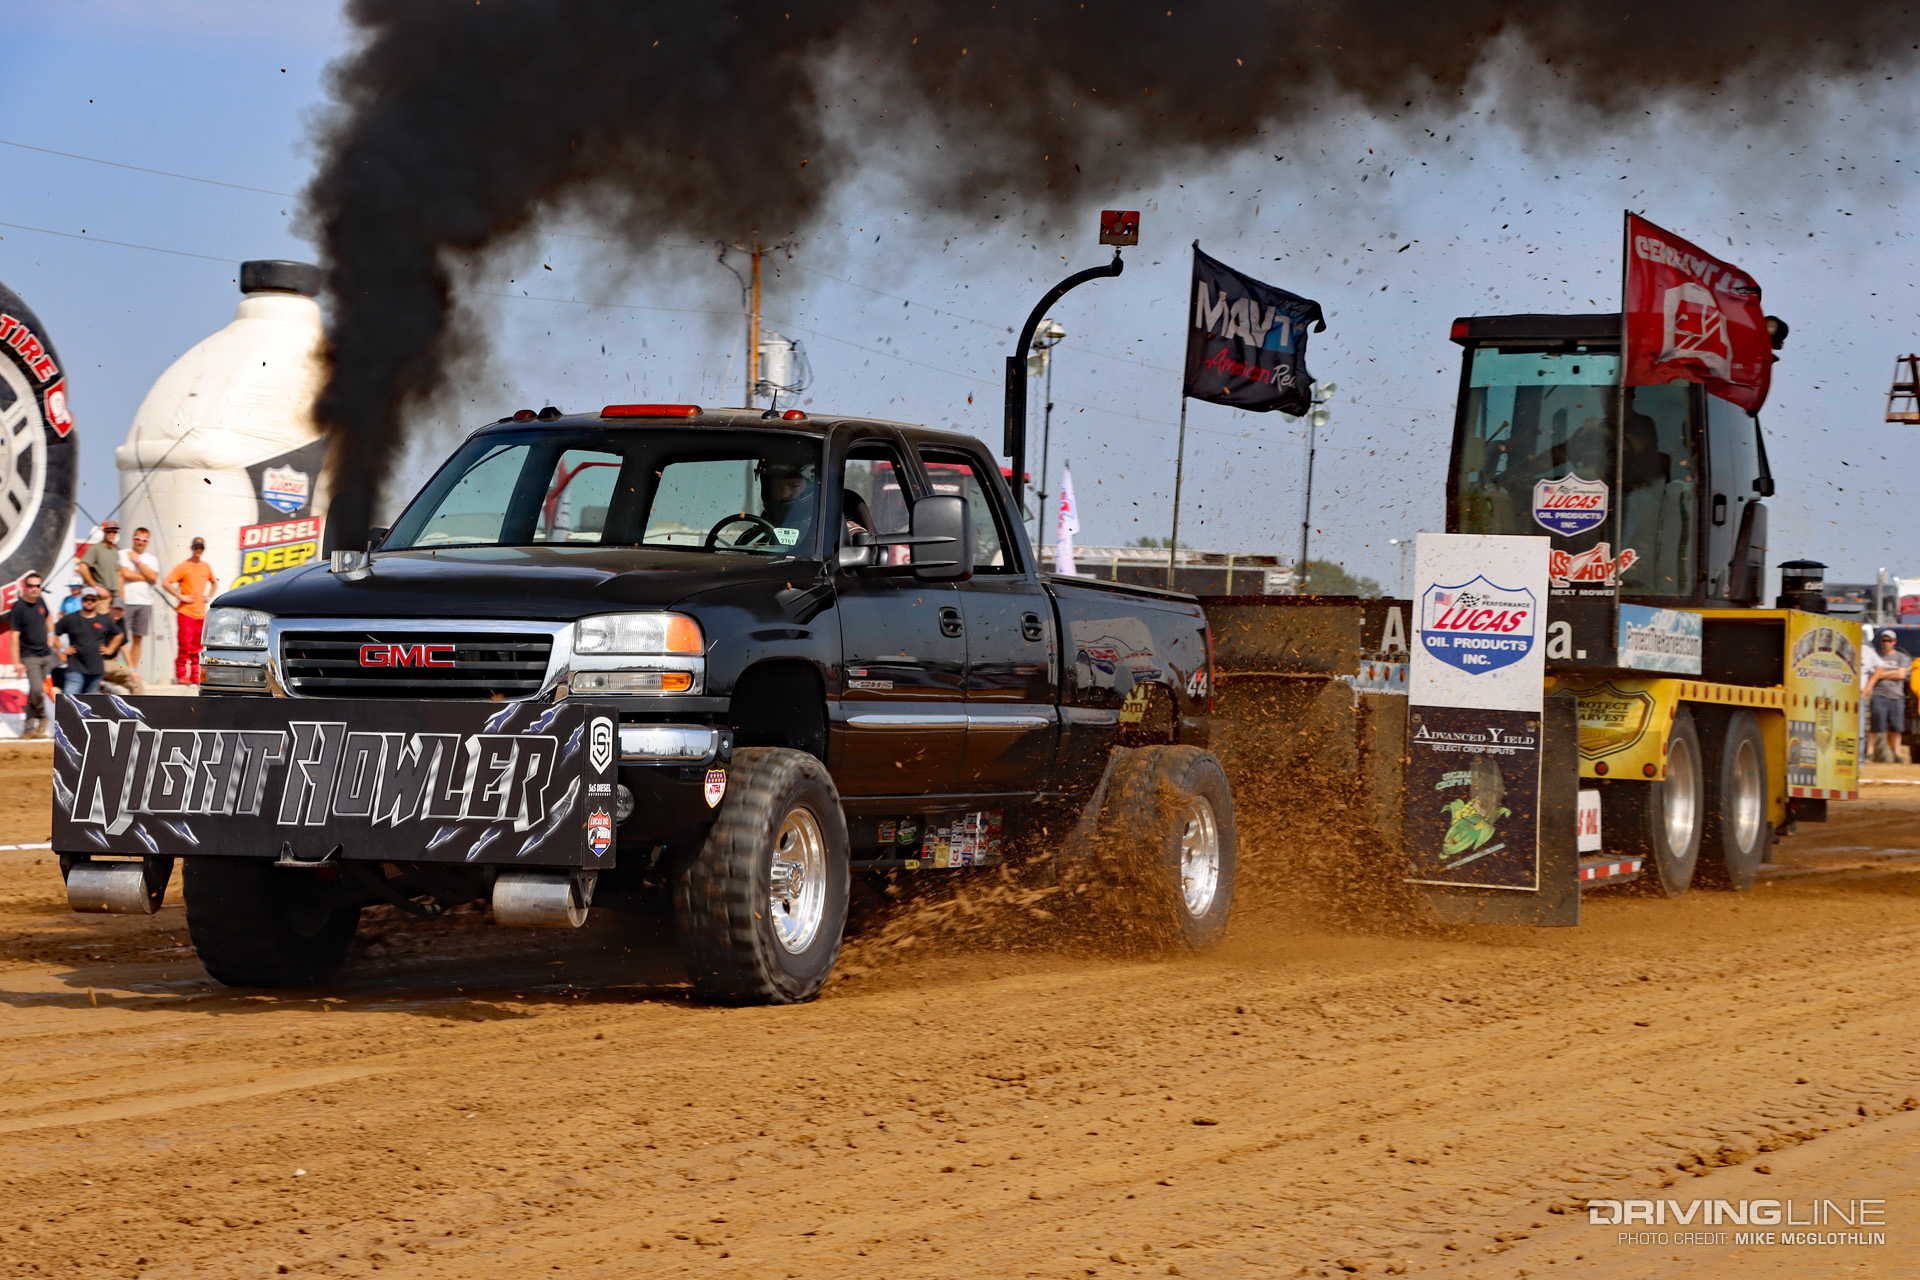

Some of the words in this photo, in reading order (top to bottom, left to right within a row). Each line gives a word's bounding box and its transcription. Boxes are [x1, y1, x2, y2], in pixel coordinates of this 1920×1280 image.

[1543, 495, 1602, 509] LUCAS
[1538, 511, 1554, 519] OIL
[1554, 511, 1602, 520] PRODUCTS
[1560, 521, 1579, 529] INC.
[243, 520, 317, 546] DIESEL
[242, 541, 317, 574] DEEP
[1481, 600, 1531, 608] PERFORMANCE
[1432, 607, 1528, 633] LUCAS
[1425, 636, 1450, 648] OIL
[1453, 637, 1528, 652] PRODUCTS
[360, 643, 456, 668] GMC
[1462, 653, 1492, 666] INC.
[1577, 700, 1631, 710] ROTECT
[1577, 713, 1629, 722] ARVEST
[1431, 744, 1461, 753] SELECT
[1462, 745, 1486, 754] CROP
[1486, 747, 1516, 756] INPUTS
[71, 718, 290, 836] NIGHT
[276, 720, 560, 834] HOWLER
[596, 783, 612, 793] DIESEL
